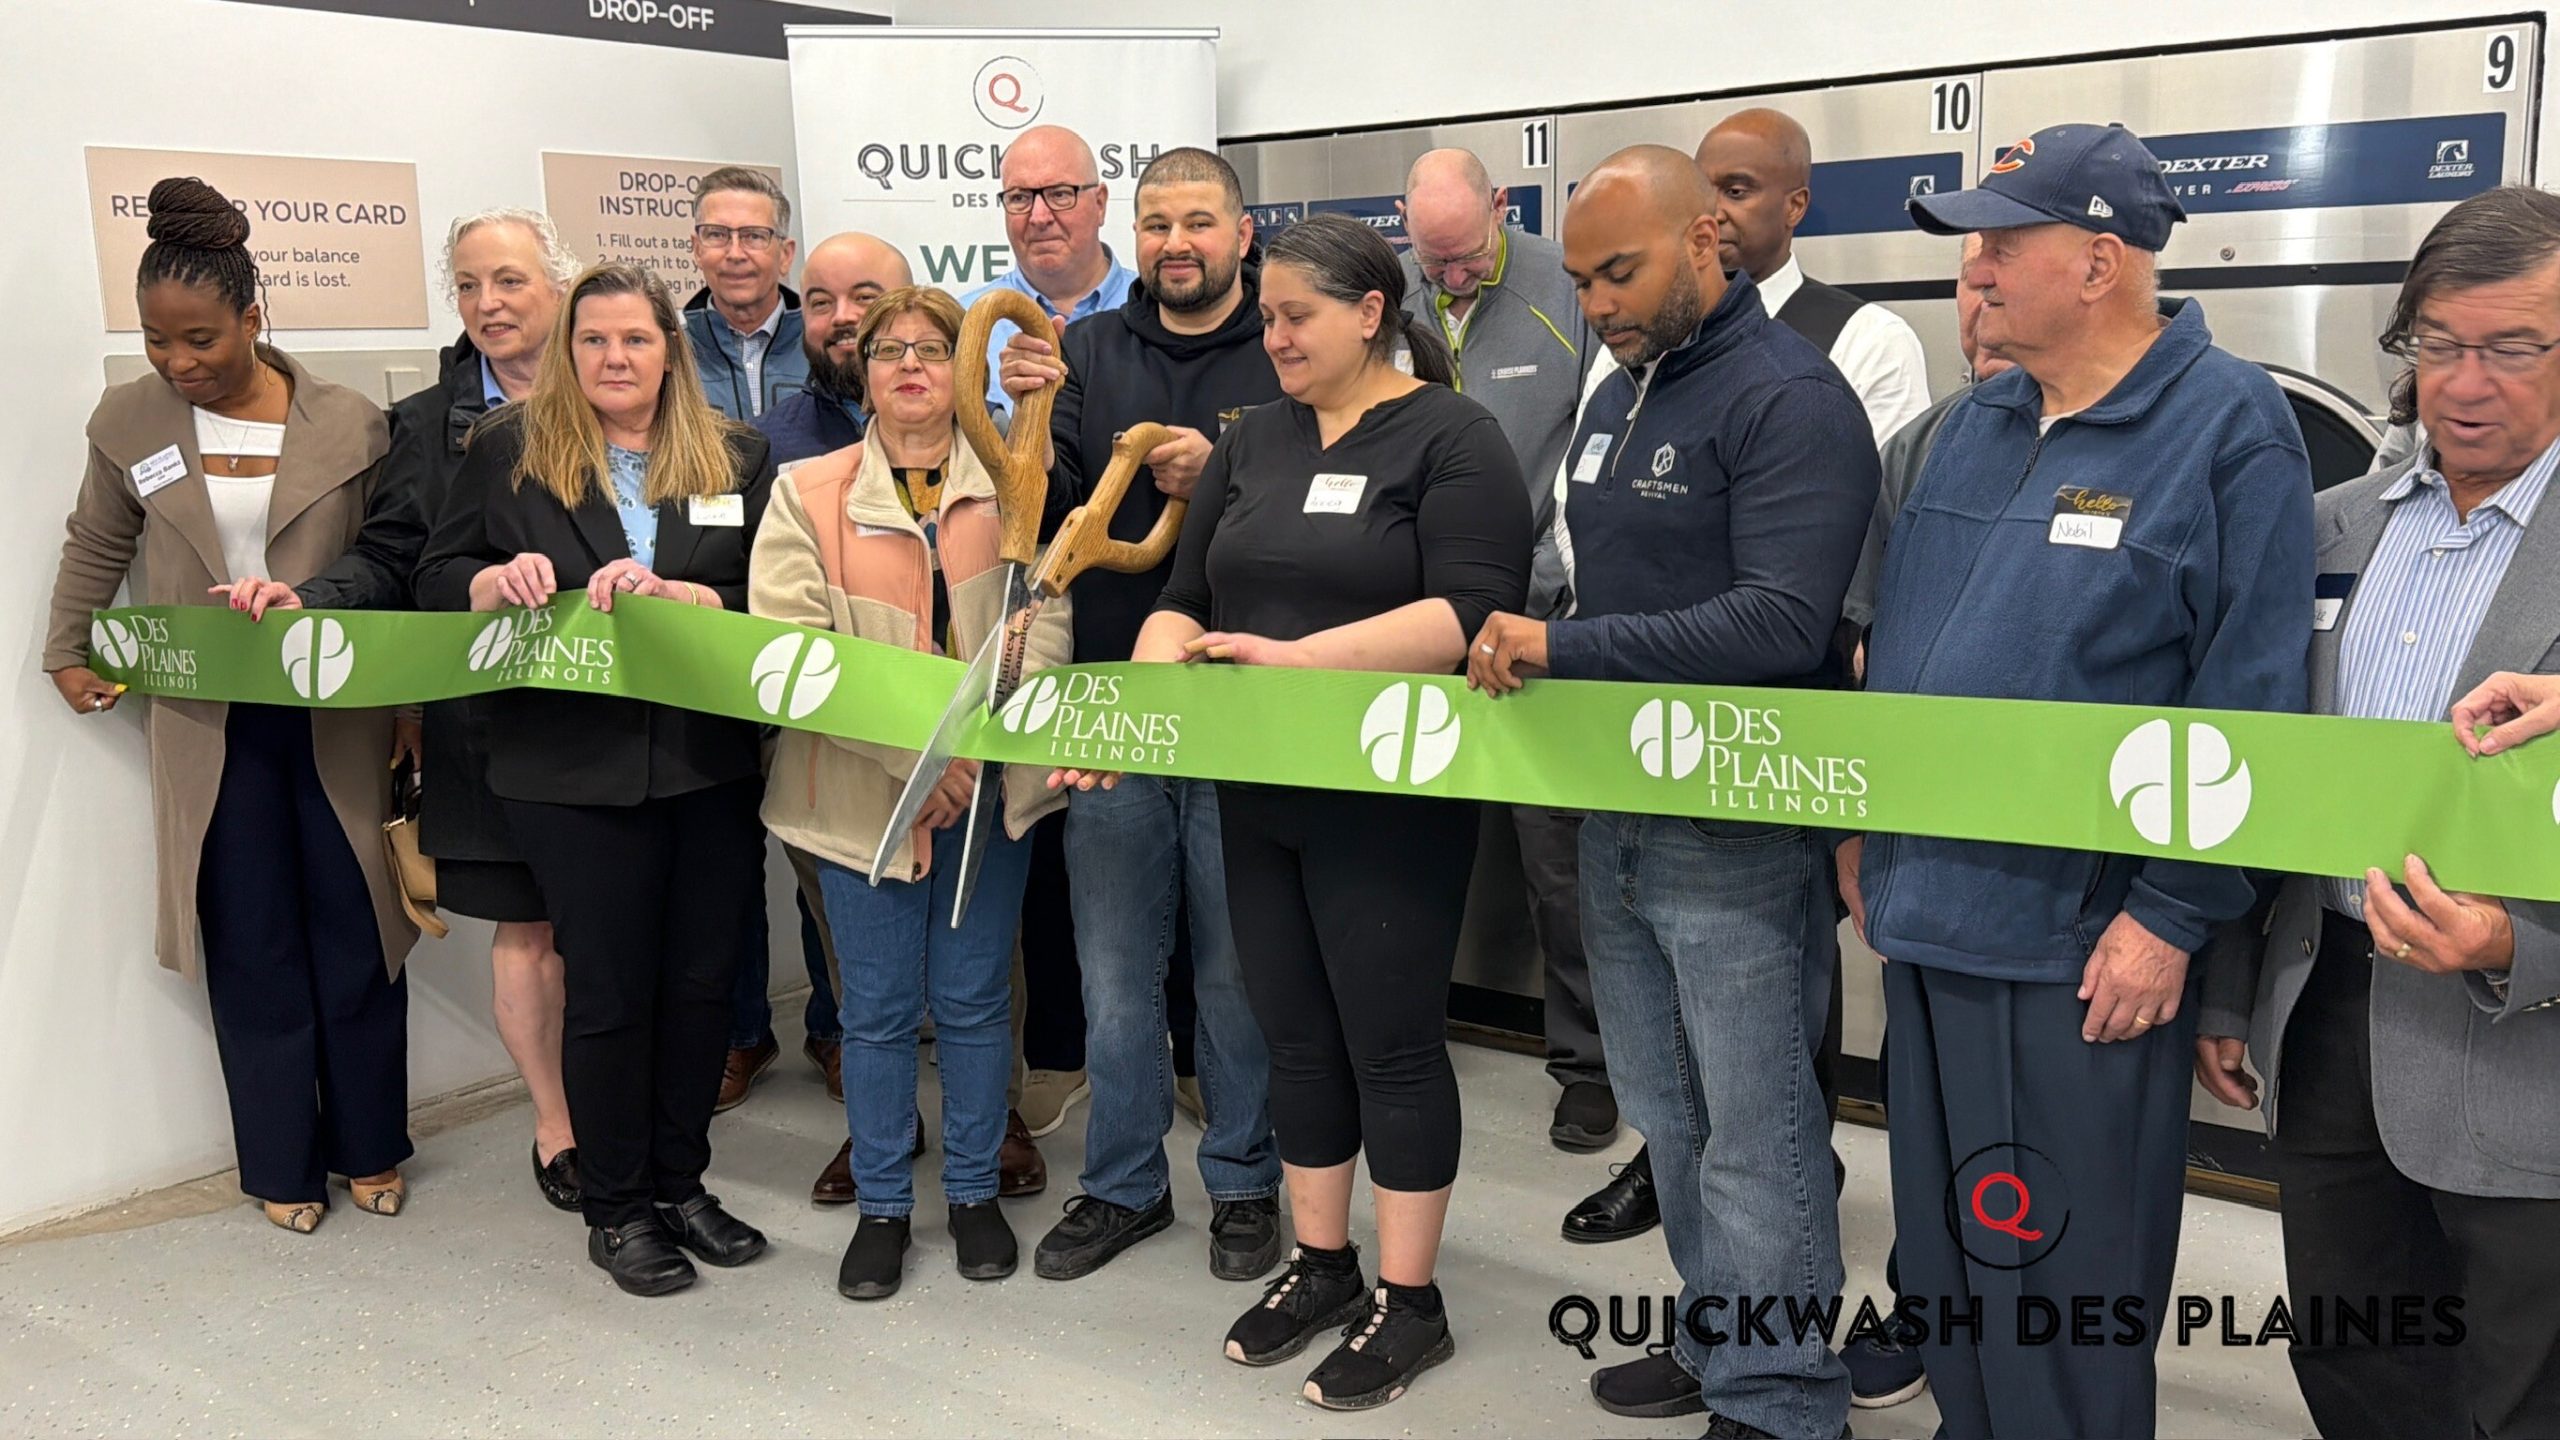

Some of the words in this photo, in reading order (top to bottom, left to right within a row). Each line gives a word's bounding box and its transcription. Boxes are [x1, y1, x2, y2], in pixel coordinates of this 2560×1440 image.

[588, 0, 716, 31] DROP-OFF
[2487, 34, 2514, 90] 9
[988, 72, 1029, 114] Q
[1932, 81, 1972, 132] 10
[1524, 121, 1549, 166] 11
[858, 143, 1160, 190] QUICSH
[620, 171, 702, 194] DROP-O
[2174, 184, 2212, 196] YER
[255, 200, 330, 224] YOUR
[336, 203, 407, 226] CARD
[599, 196, 696, 218] INSTRUCT
[952, 193, 988, 208] DES
[292, 248, 361, 264] balance
[596, 233, 607, 247] 1.
[610, 234, 632, 248] Fill
[634, 236, 658, 249] out
[661, 239, 669, 249] a
[672, 237, 695, 253] tag
[663, 255, 673, 269] it
[676, 257, 690, 269] to
[256, 270, 291, 287] ard
[298, 271, 309, 287] is
[315, 270, 351, 288] lost.
[666, 279, 682, 294] ag
[685, 277, 697, 290] in
[1631, 478, 1689, 495] CRAFTSMEN
[2056, 520, 2094, 539] Nabil
[129, 615, 169, 643] DES
[513, 605, 557, 635] DES
[140, 642, 197, 676] PLAINES
[505, 636, 615, 669] PLAINES
[143, 675, 198, 690] ILLINOIS
[497, 665, 612, 685] ILLINOIS
[1061, 671, 1123, 706] DES
[1051, 705, 1181, 747] PLAINES
[1706, 700, 1782, 746] DES
[1049, 741, 1177, 766] ILLINOIS
[1707, 744, 1868, 797] PLAINES
[1709, 788, 1869, 818] ILLINOIS
